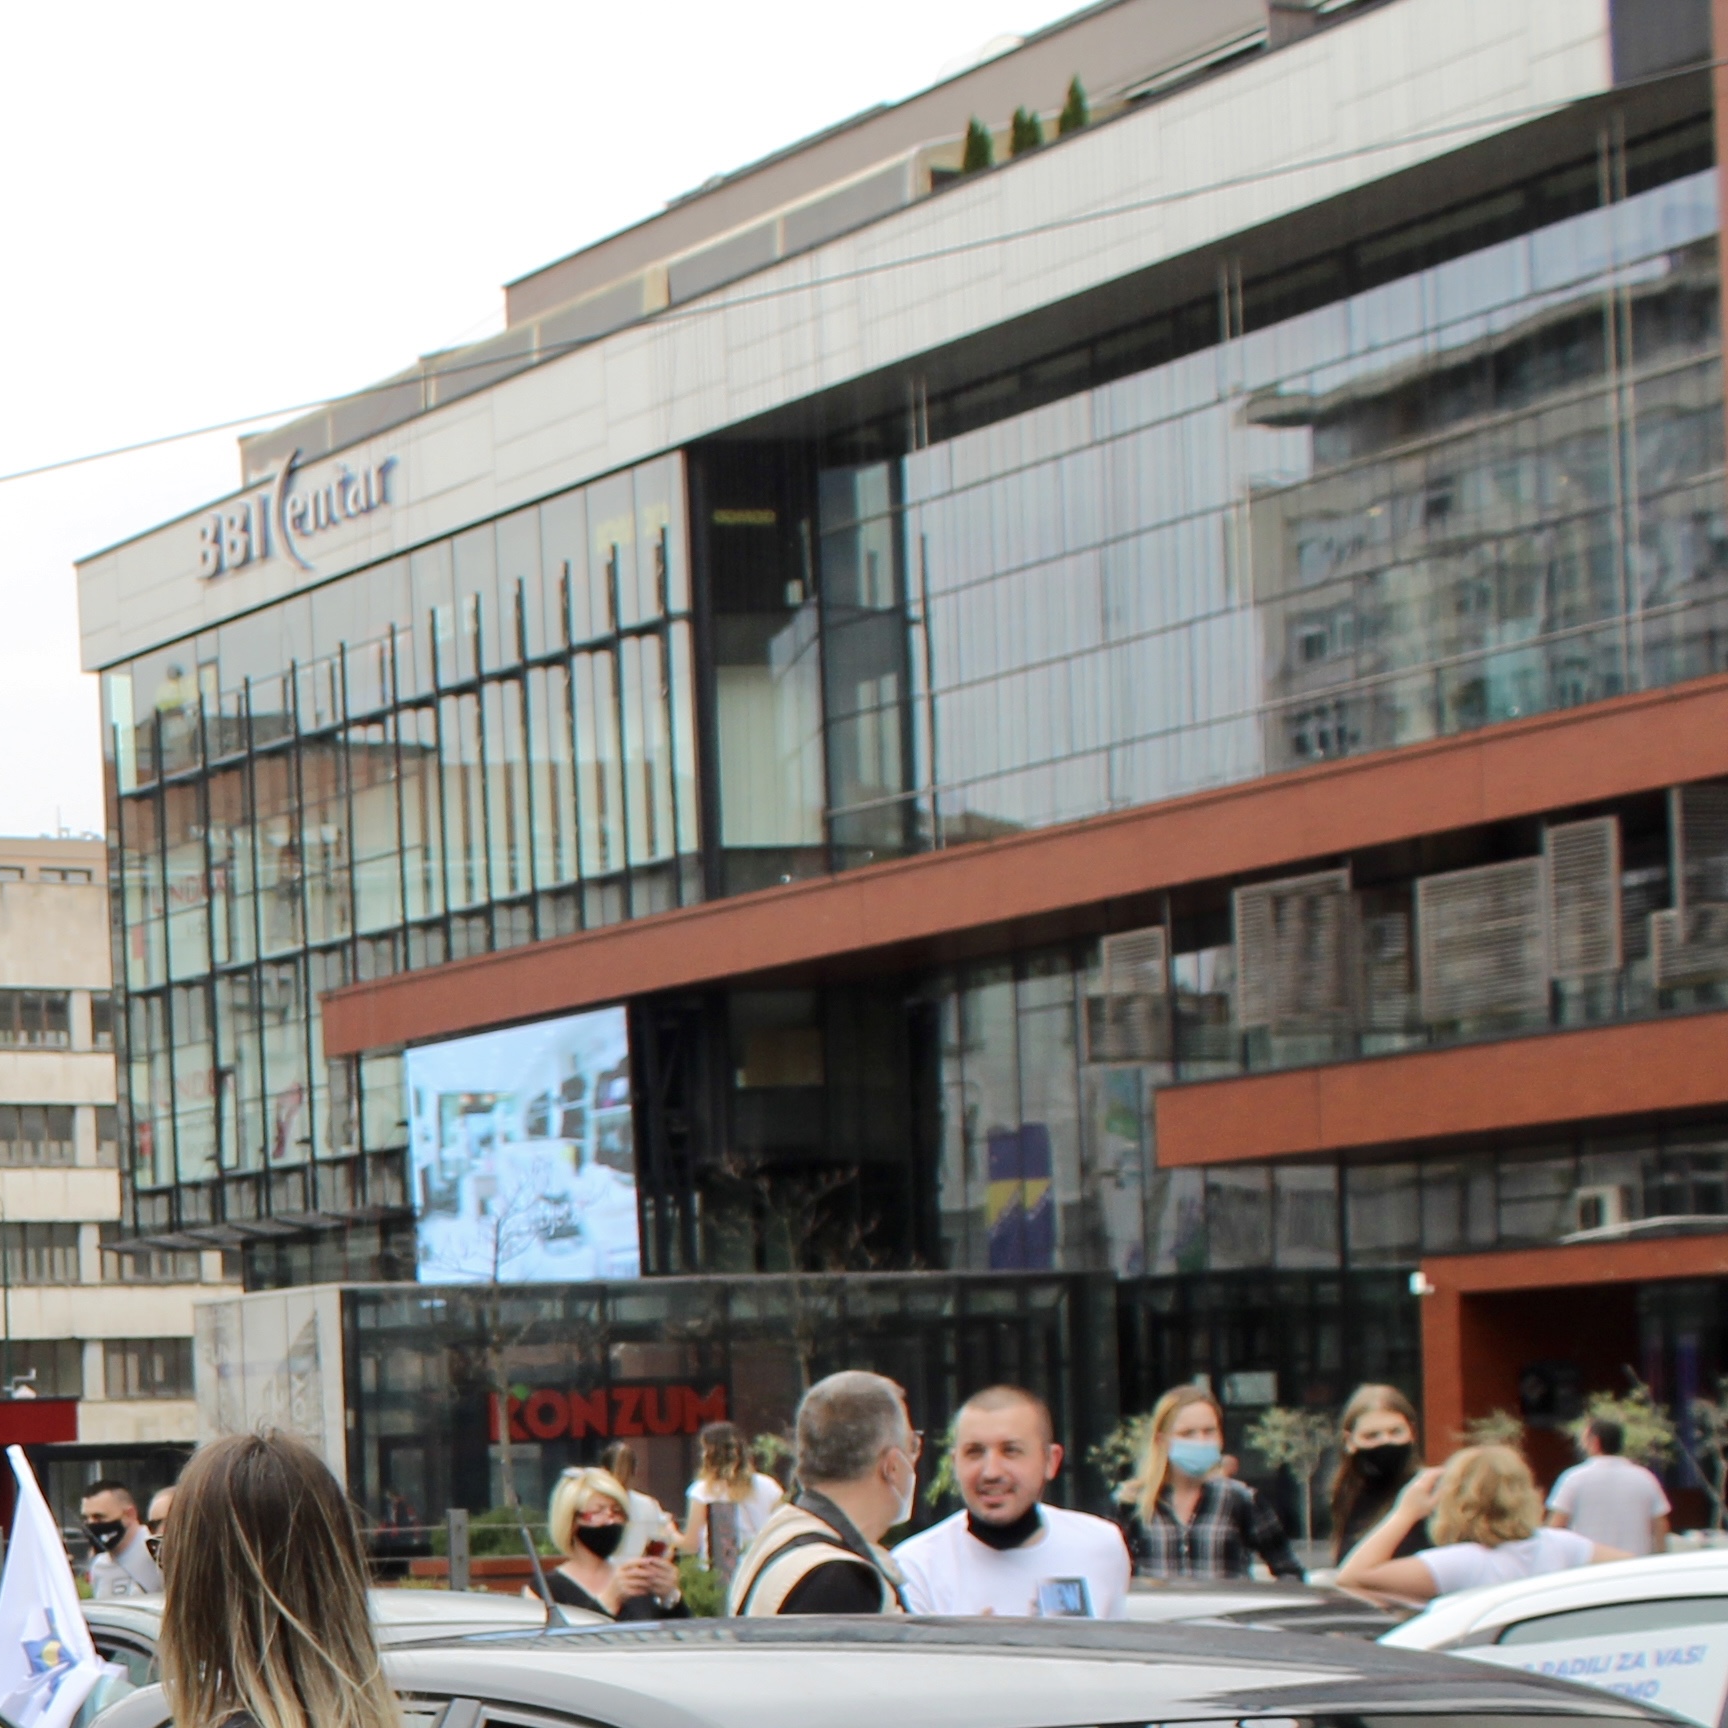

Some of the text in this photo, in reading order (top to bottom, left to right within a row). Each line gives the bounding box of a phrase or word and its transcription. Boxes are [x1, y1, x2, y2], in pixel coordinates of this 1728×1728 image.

[197, 447, 401, 580] BBI Centar
[489, 1384, 728, 1440] KONZUM
[1543, 1654, 1614, 1679] RADILI
[1616, 1652, 1646, 1672] ZA
